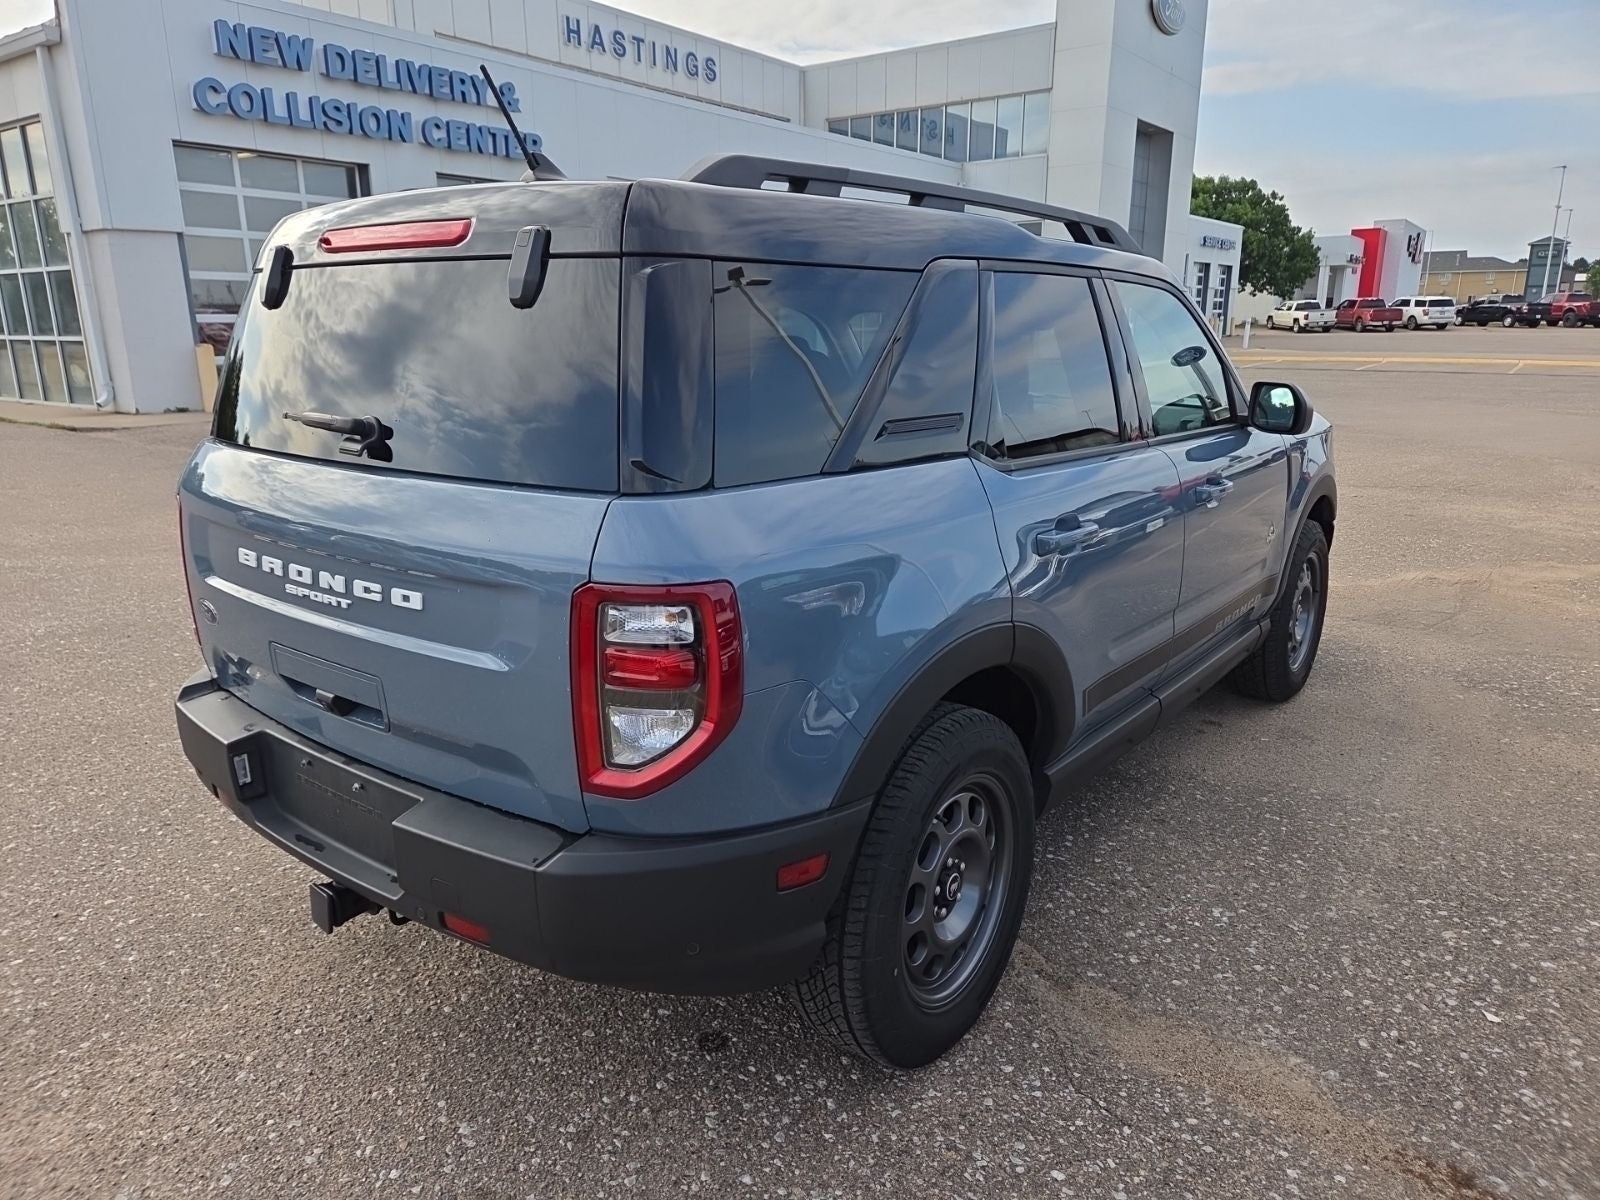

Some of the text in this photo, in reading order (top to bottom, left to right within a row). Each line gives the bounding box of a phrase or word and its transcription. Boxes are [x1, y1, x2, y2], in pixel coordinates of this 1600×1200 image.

[213, 19, 522, 113] NEW DELIVERY &
[564, 15, 717, 82] HASTINGS
[192, 77, 413, 144] COLLISION
[238, 547, 424, 611] BRONCO
[284, 584, 352, 609] SPORT
